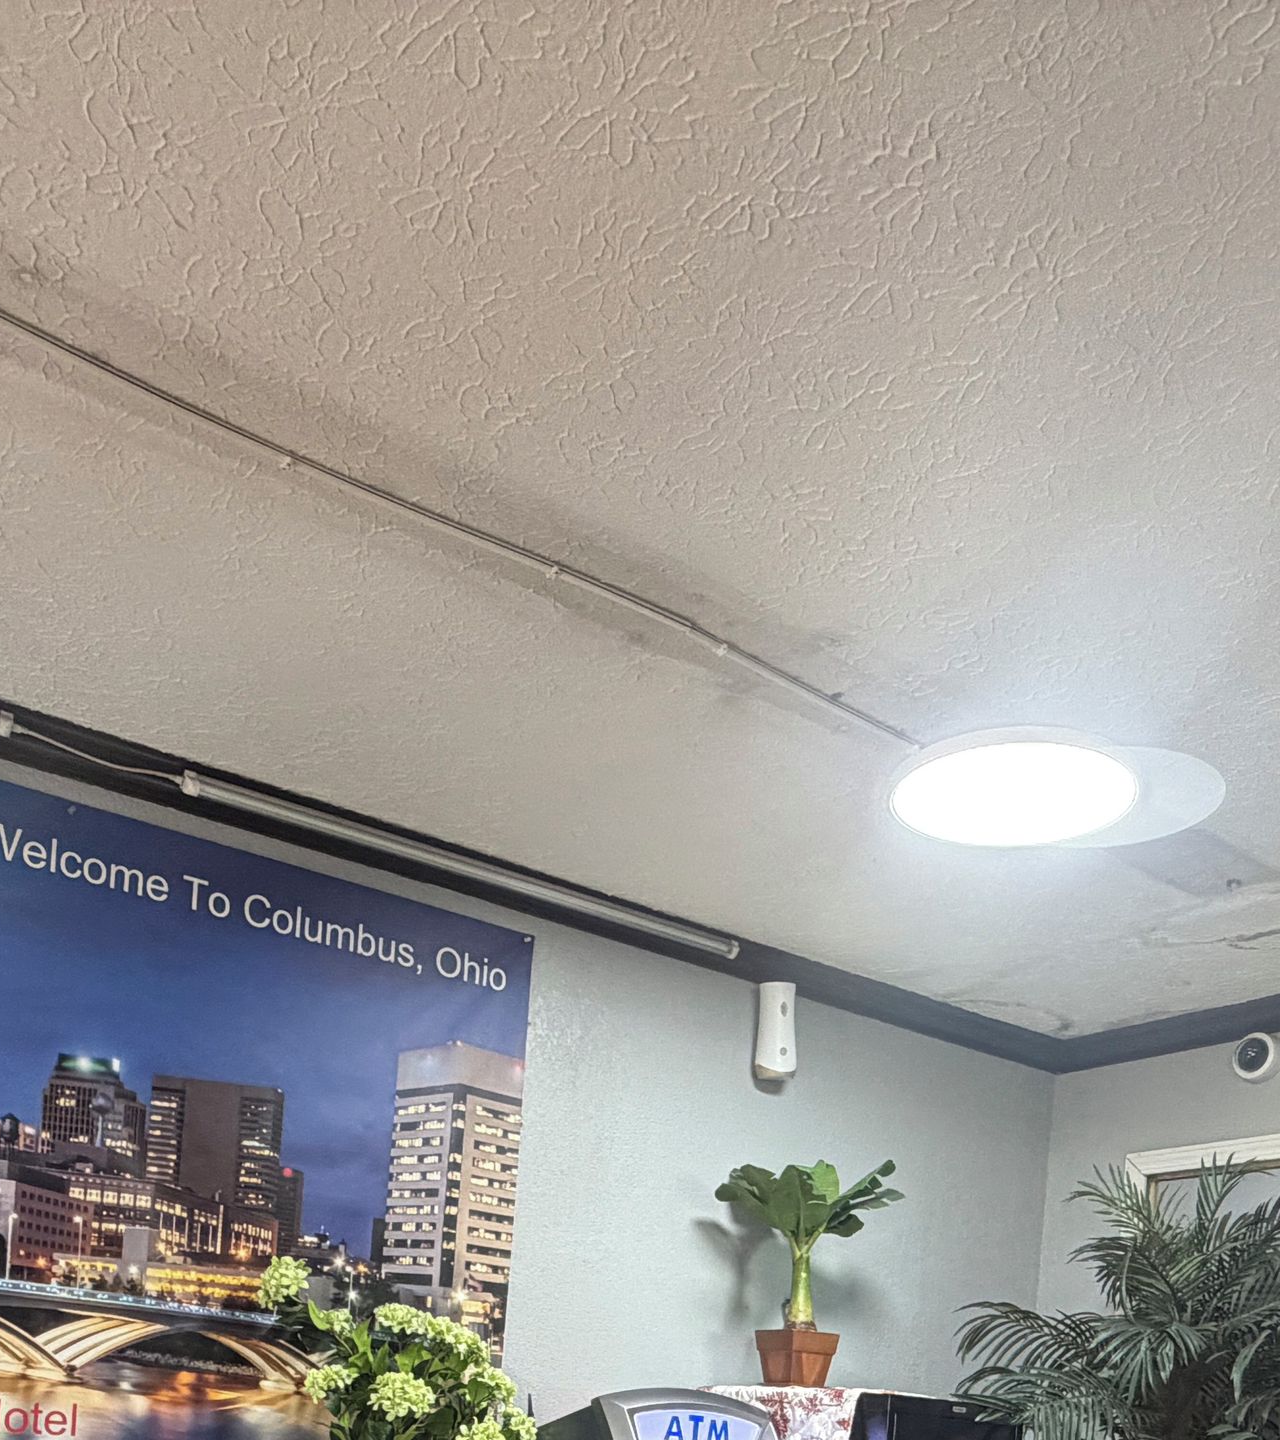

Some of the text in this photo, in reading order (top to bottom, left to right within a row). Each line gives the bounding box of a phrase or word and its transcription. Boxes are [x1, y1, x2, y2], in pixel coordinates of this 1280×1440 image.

[183, 874, 231, 918] To
[244, 894, 422, 975] Columbus,
[436, 947, 507, 991] Ohio
